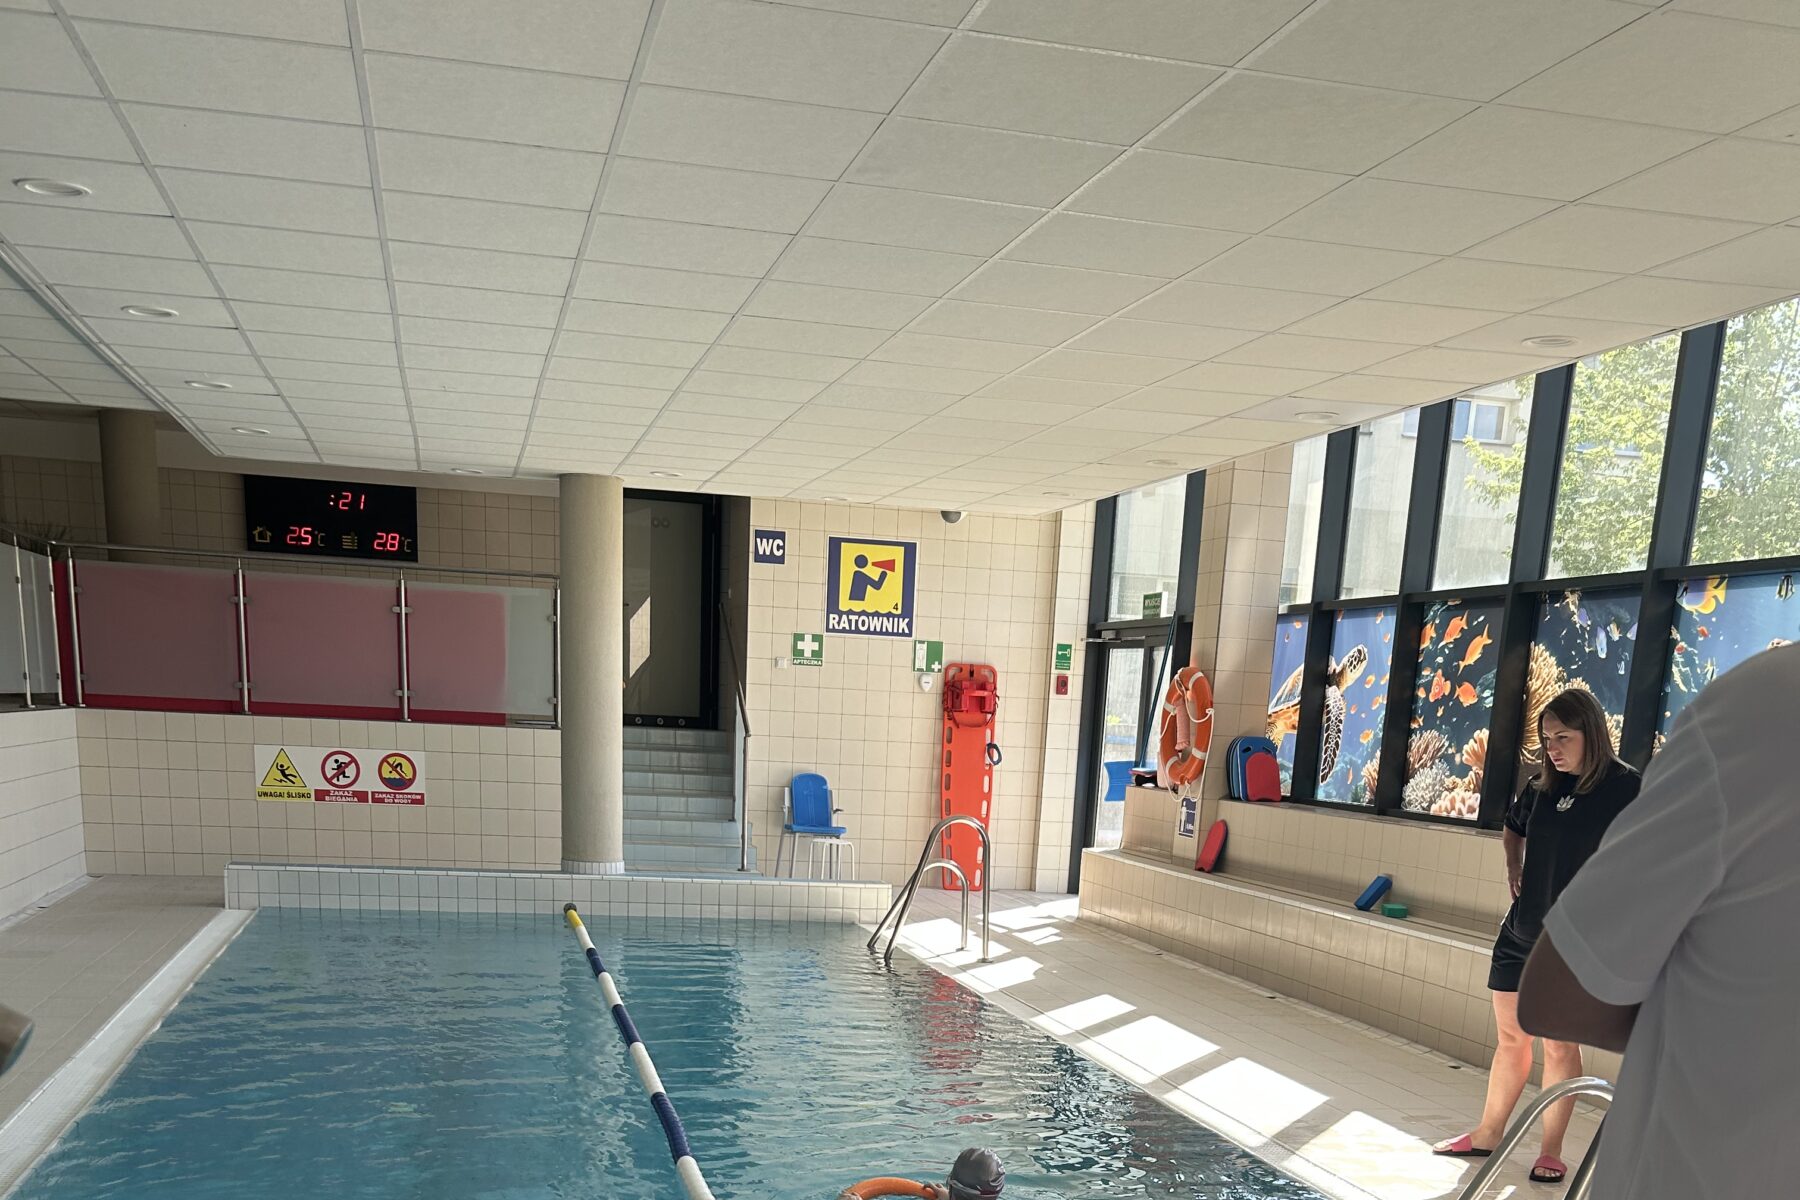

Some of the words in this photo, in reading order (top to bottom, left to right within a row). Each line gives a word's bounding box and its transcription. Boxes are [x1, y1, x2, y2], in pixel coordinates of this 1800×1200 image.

[756, 537, 784, 557] WC
[892, 602, 899, 612] 4
[828, 613, 910, 635] RATOWNIK
[793, 658, 822, 666] APTECZKA
[257, 790, 285, 798] UWAGA!
[286, 790, 312, 799] ŚLISKO
[324, 795, 359, 803] BIEGANIA
